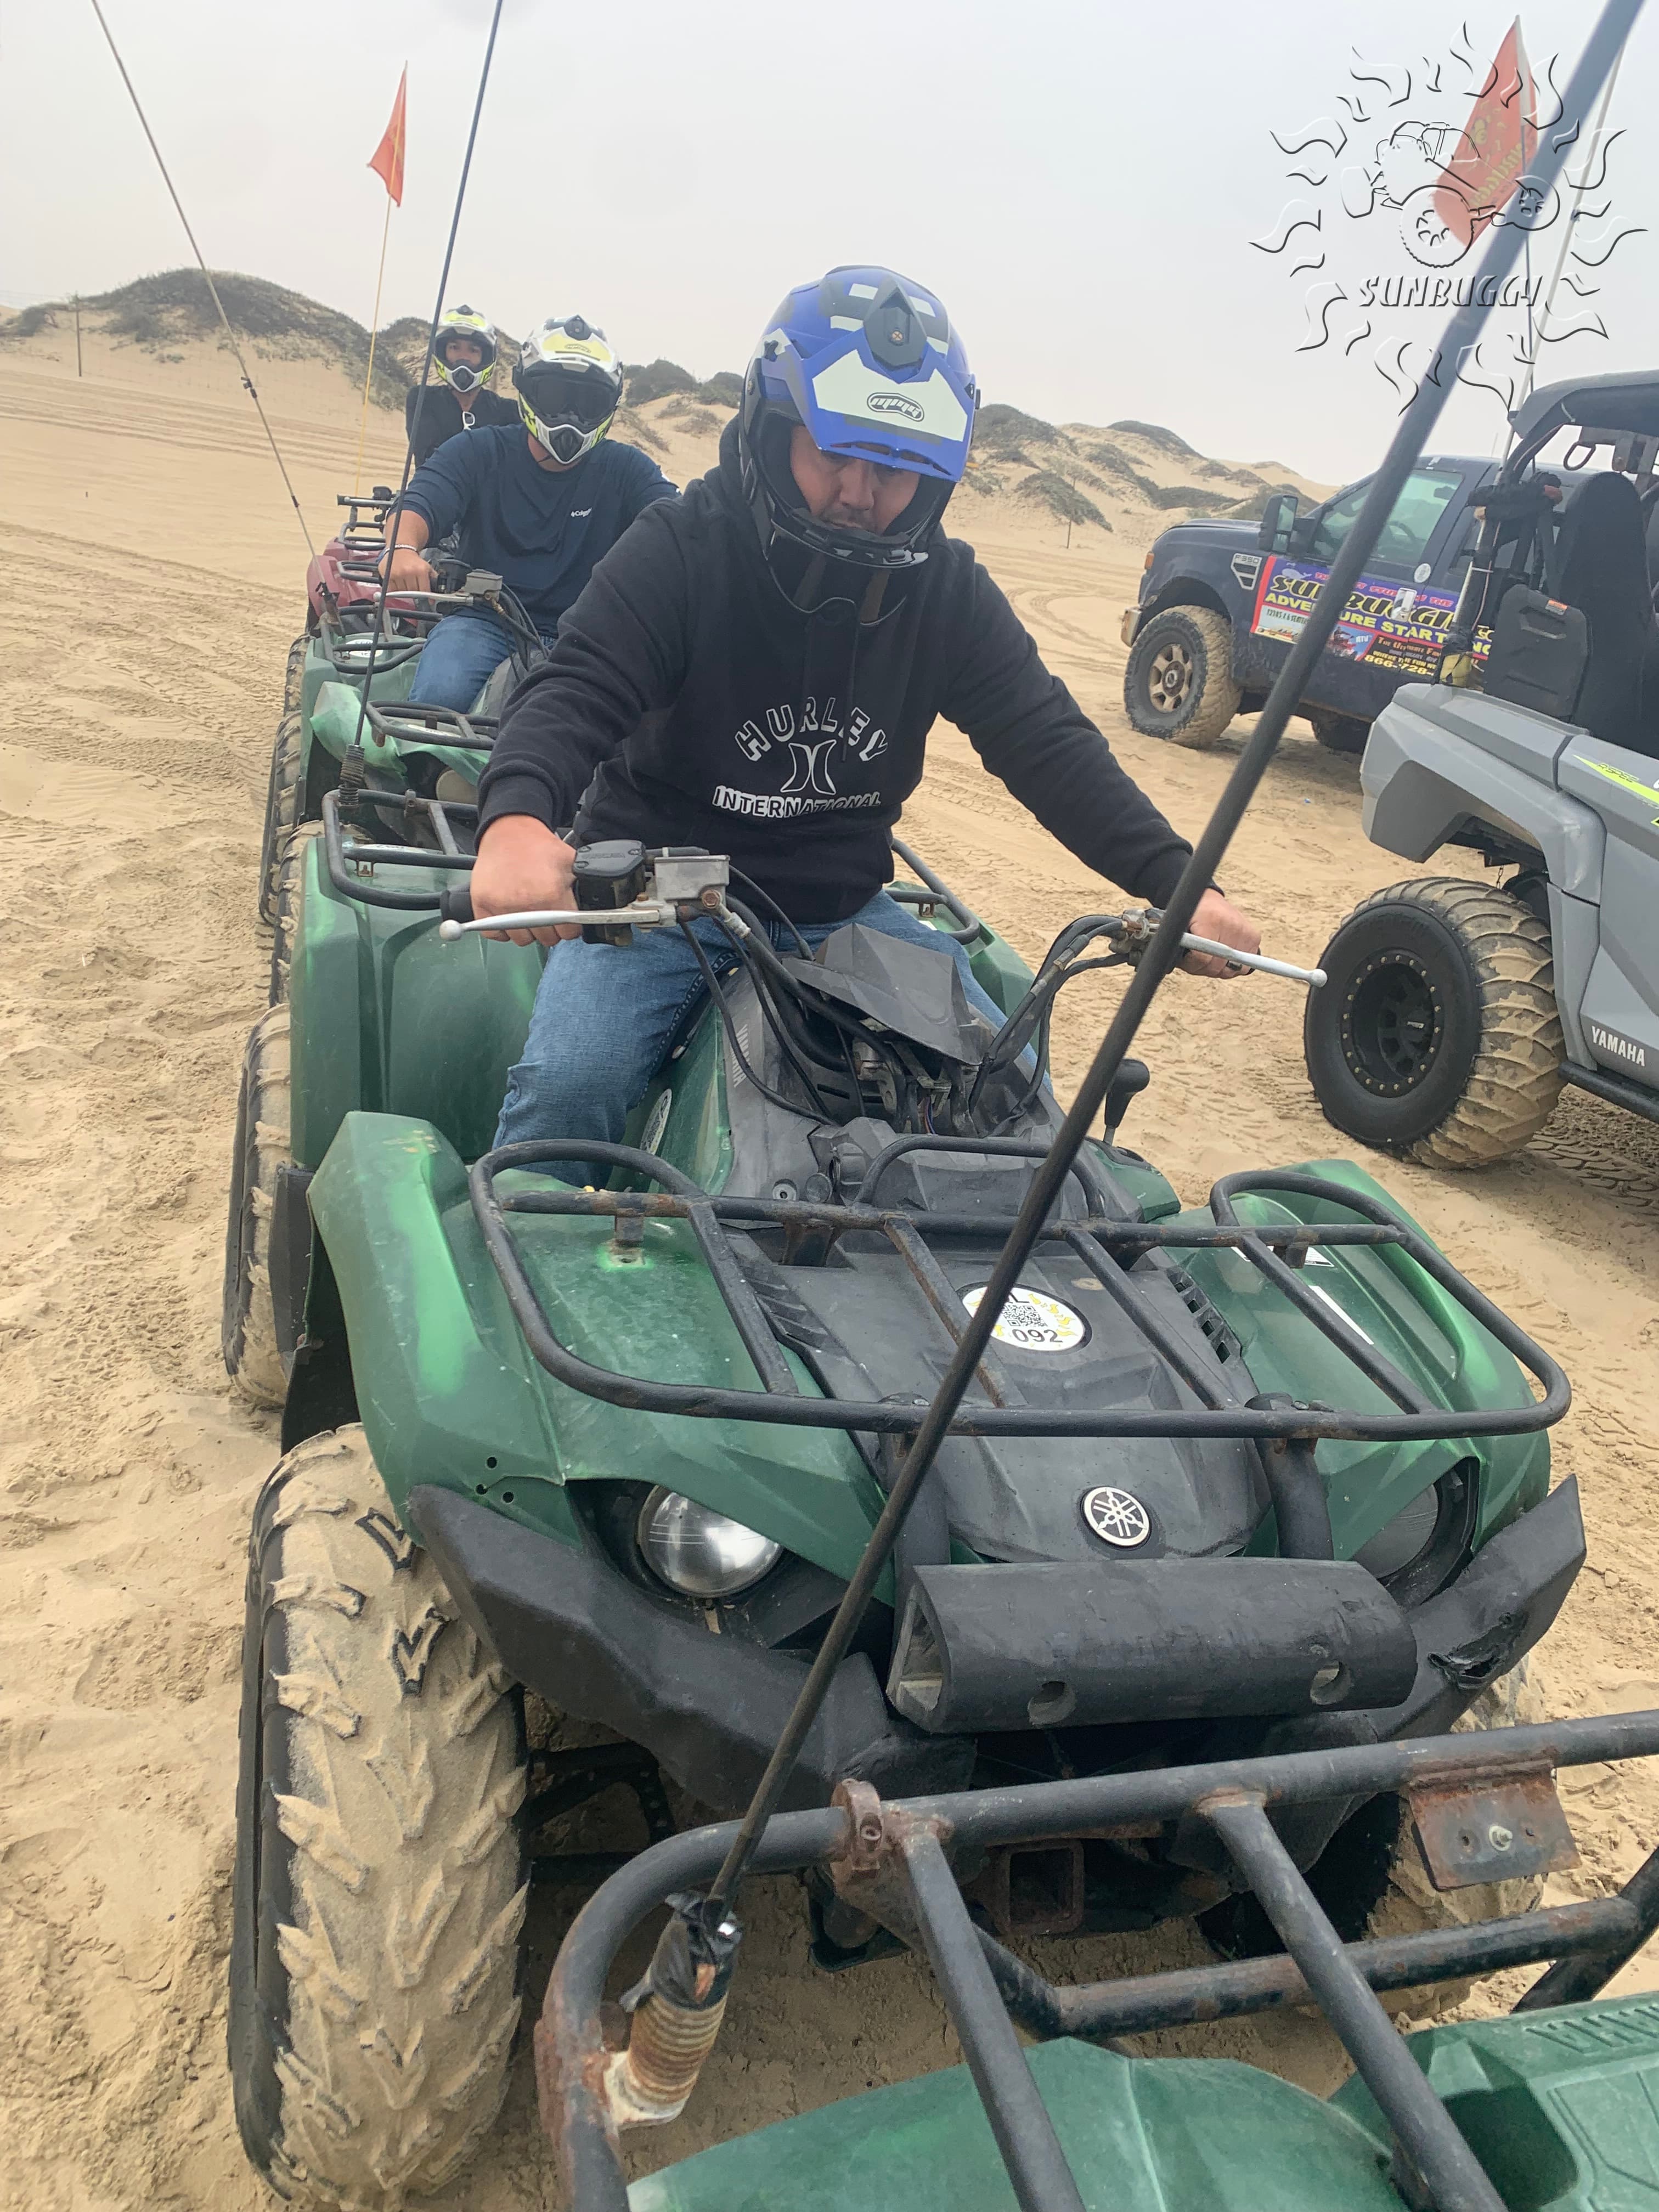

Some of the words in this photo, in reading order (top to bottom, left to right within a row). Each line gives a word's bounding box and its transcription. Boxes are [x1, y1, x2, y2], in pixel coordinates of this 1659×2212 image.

[734, 696, 888, 761] HURLEY
[712, 785, 882, 817] INTERNATIONAL
[1592, 1025, 1645, 1067] YAMAHA
[1012, 1329, 1063, 1342] 092
